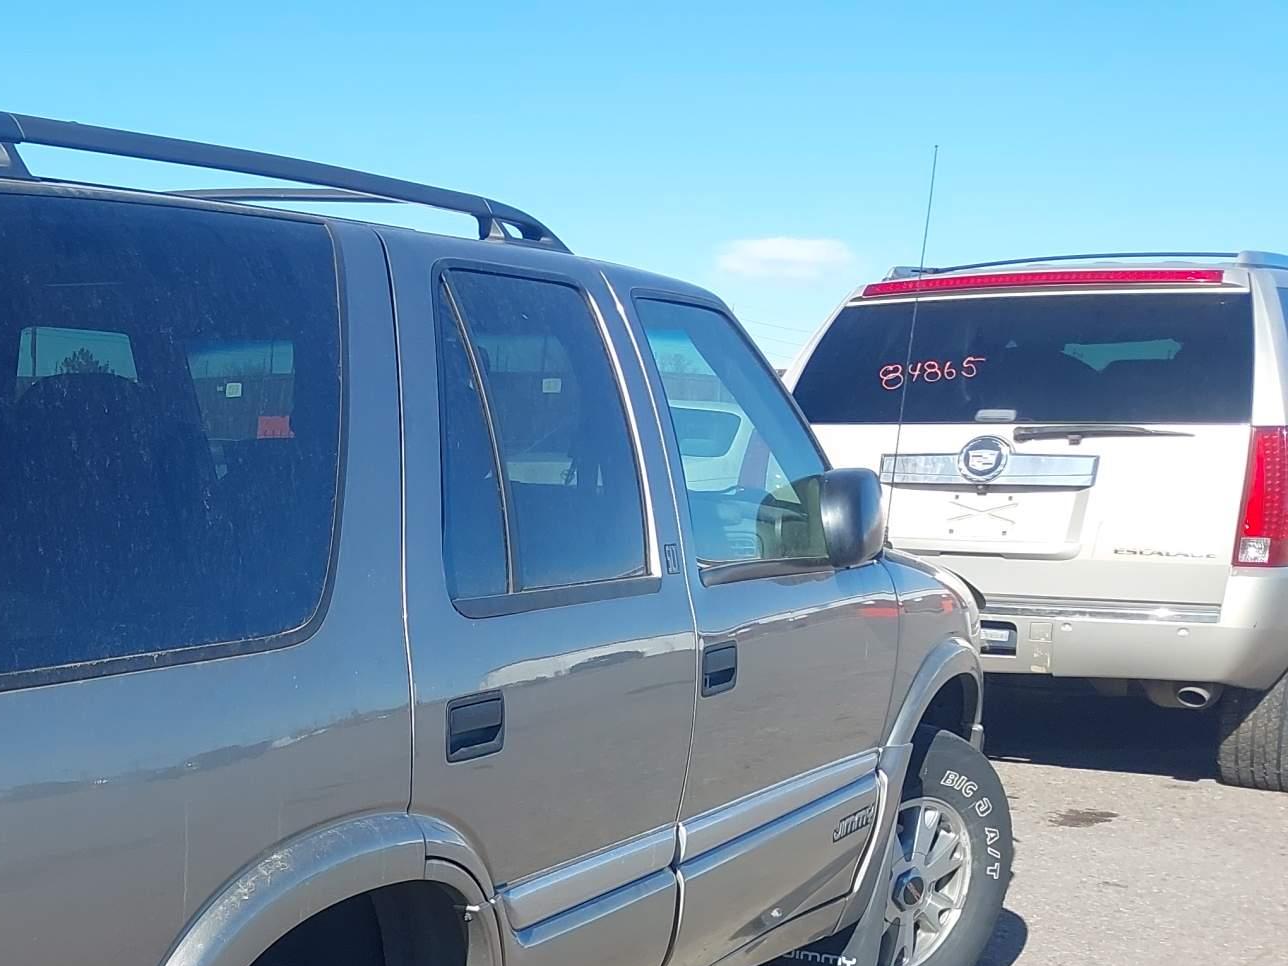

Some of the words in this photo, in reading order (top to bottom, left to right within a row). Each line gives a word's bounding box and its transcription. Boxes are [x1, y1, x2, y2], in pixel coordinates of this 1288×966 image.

[879, 356, 987, 390] 84865
[940, 770, 978, 798] BIG
[984, 826, 1001, 880] A/T
